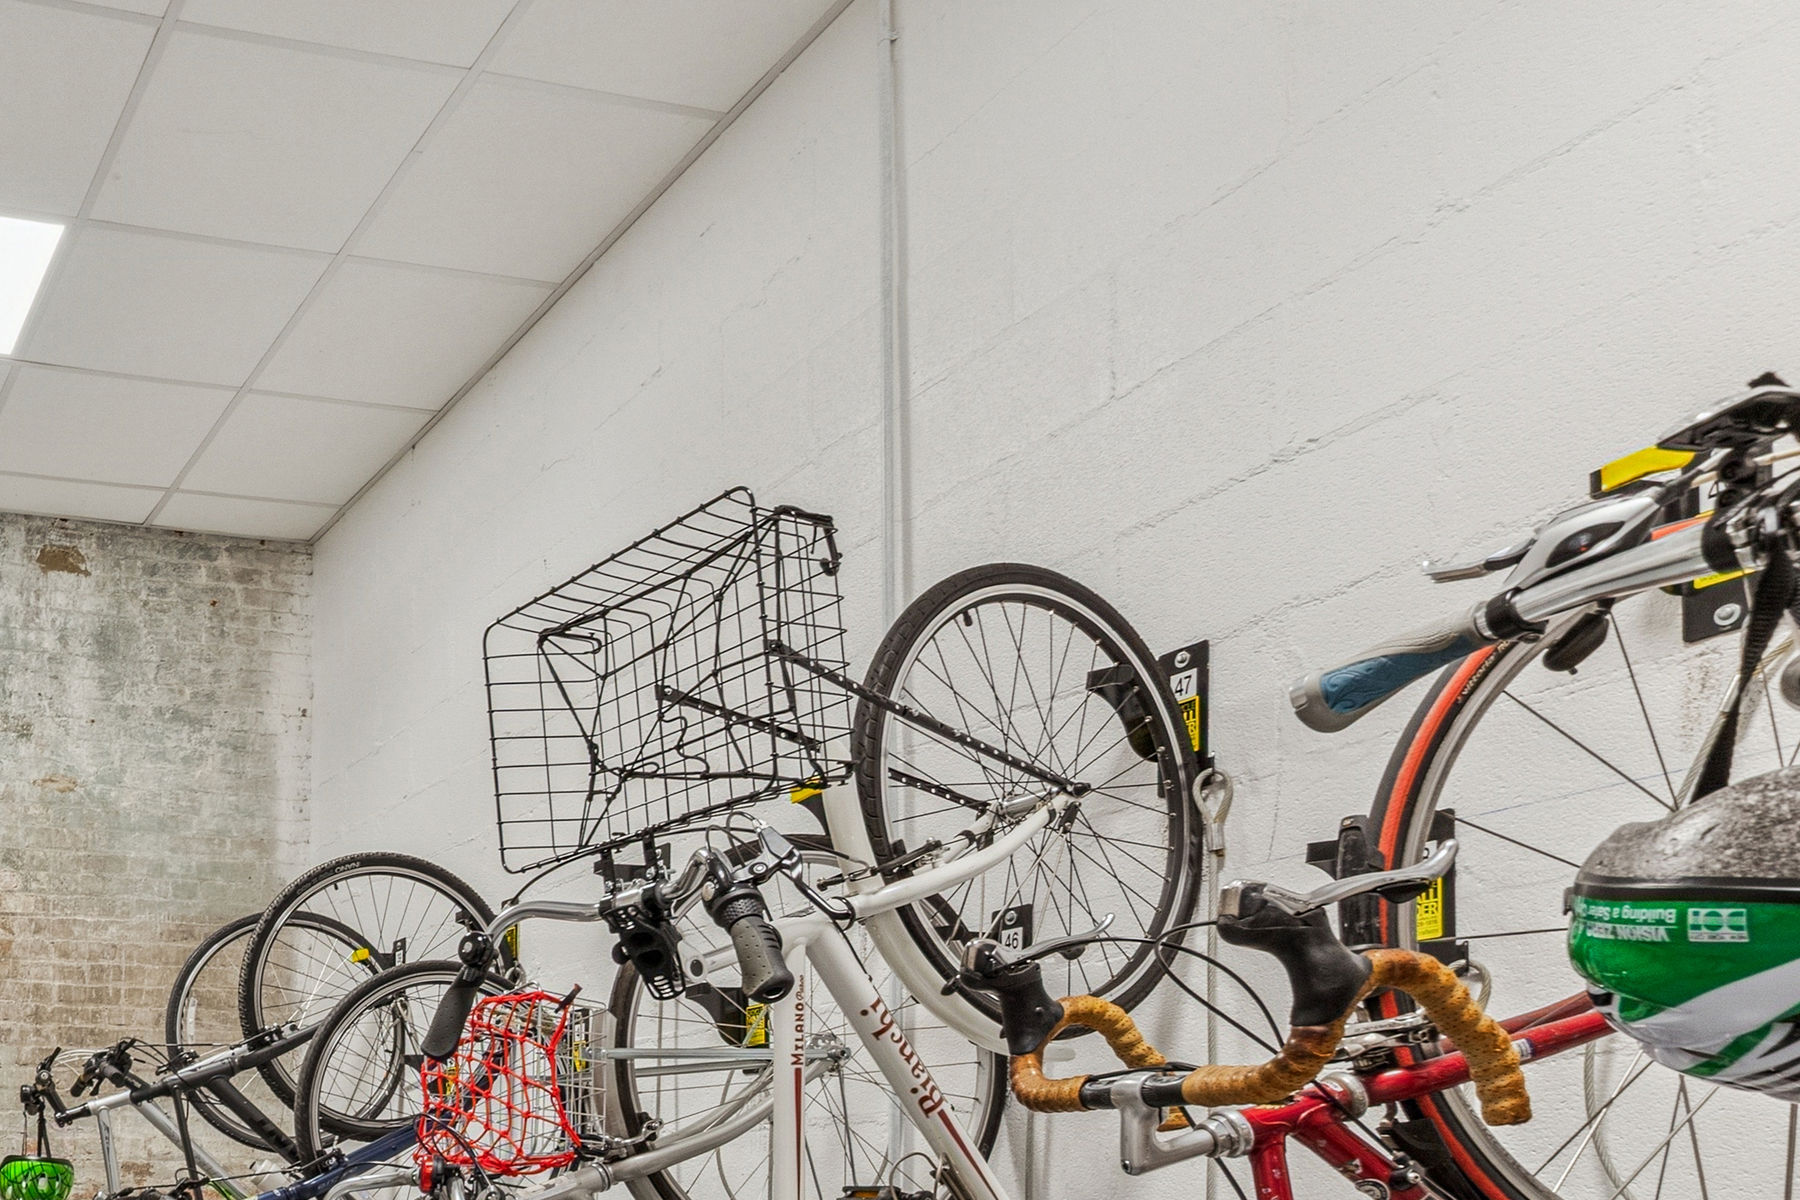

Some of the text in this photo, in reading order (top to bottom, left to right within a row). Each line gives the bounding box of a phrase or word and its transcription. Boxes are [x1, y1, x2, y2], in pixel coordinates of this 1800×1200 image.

[1174, 674, 1193, 697] 47
[1612, 906, 1620, 919] a
[1621, 904, 1677, 924] Building
[1004, 931, 1019, 950] 46
[1617, 925, 1671, 943] VISION
[790, 1003, 805, 1066] MILANO
[860, 997, 945, 1119] Bianchi
